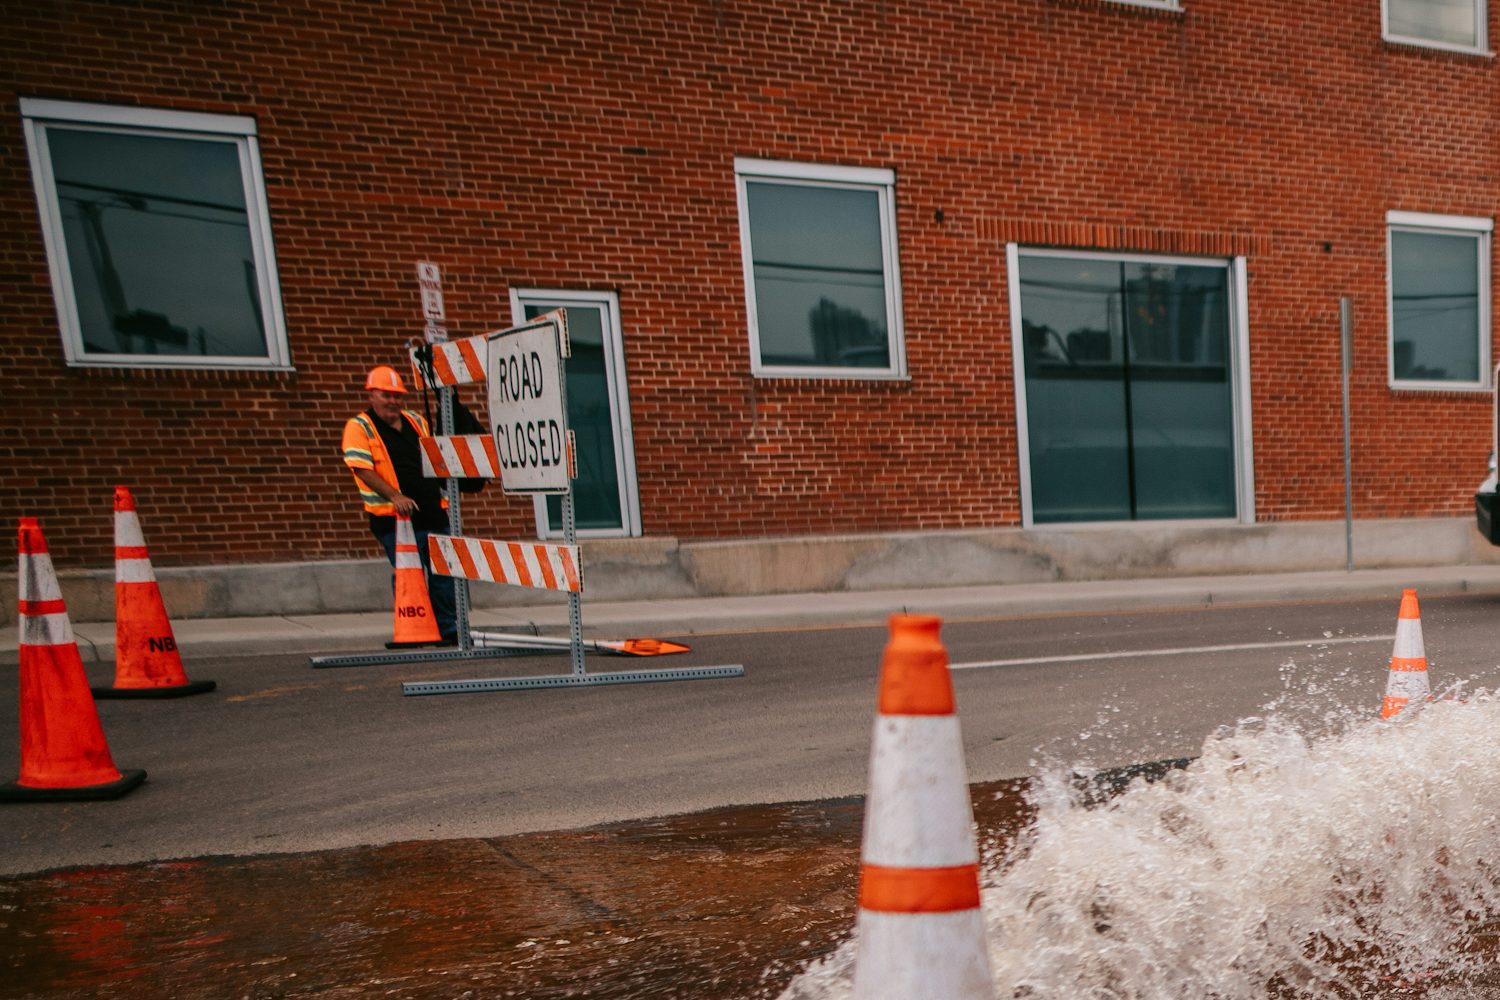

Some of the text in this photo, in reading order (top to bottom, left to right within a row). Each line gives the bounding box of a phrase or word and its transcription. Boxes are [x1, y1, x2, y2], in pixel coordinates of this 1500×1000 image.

[499, 351, 543, 403] ROAD
[497, 419, 561, 469] CLOSED
[398, 606, 426, 618] NBC
[149, 637, 177, 652] NB
